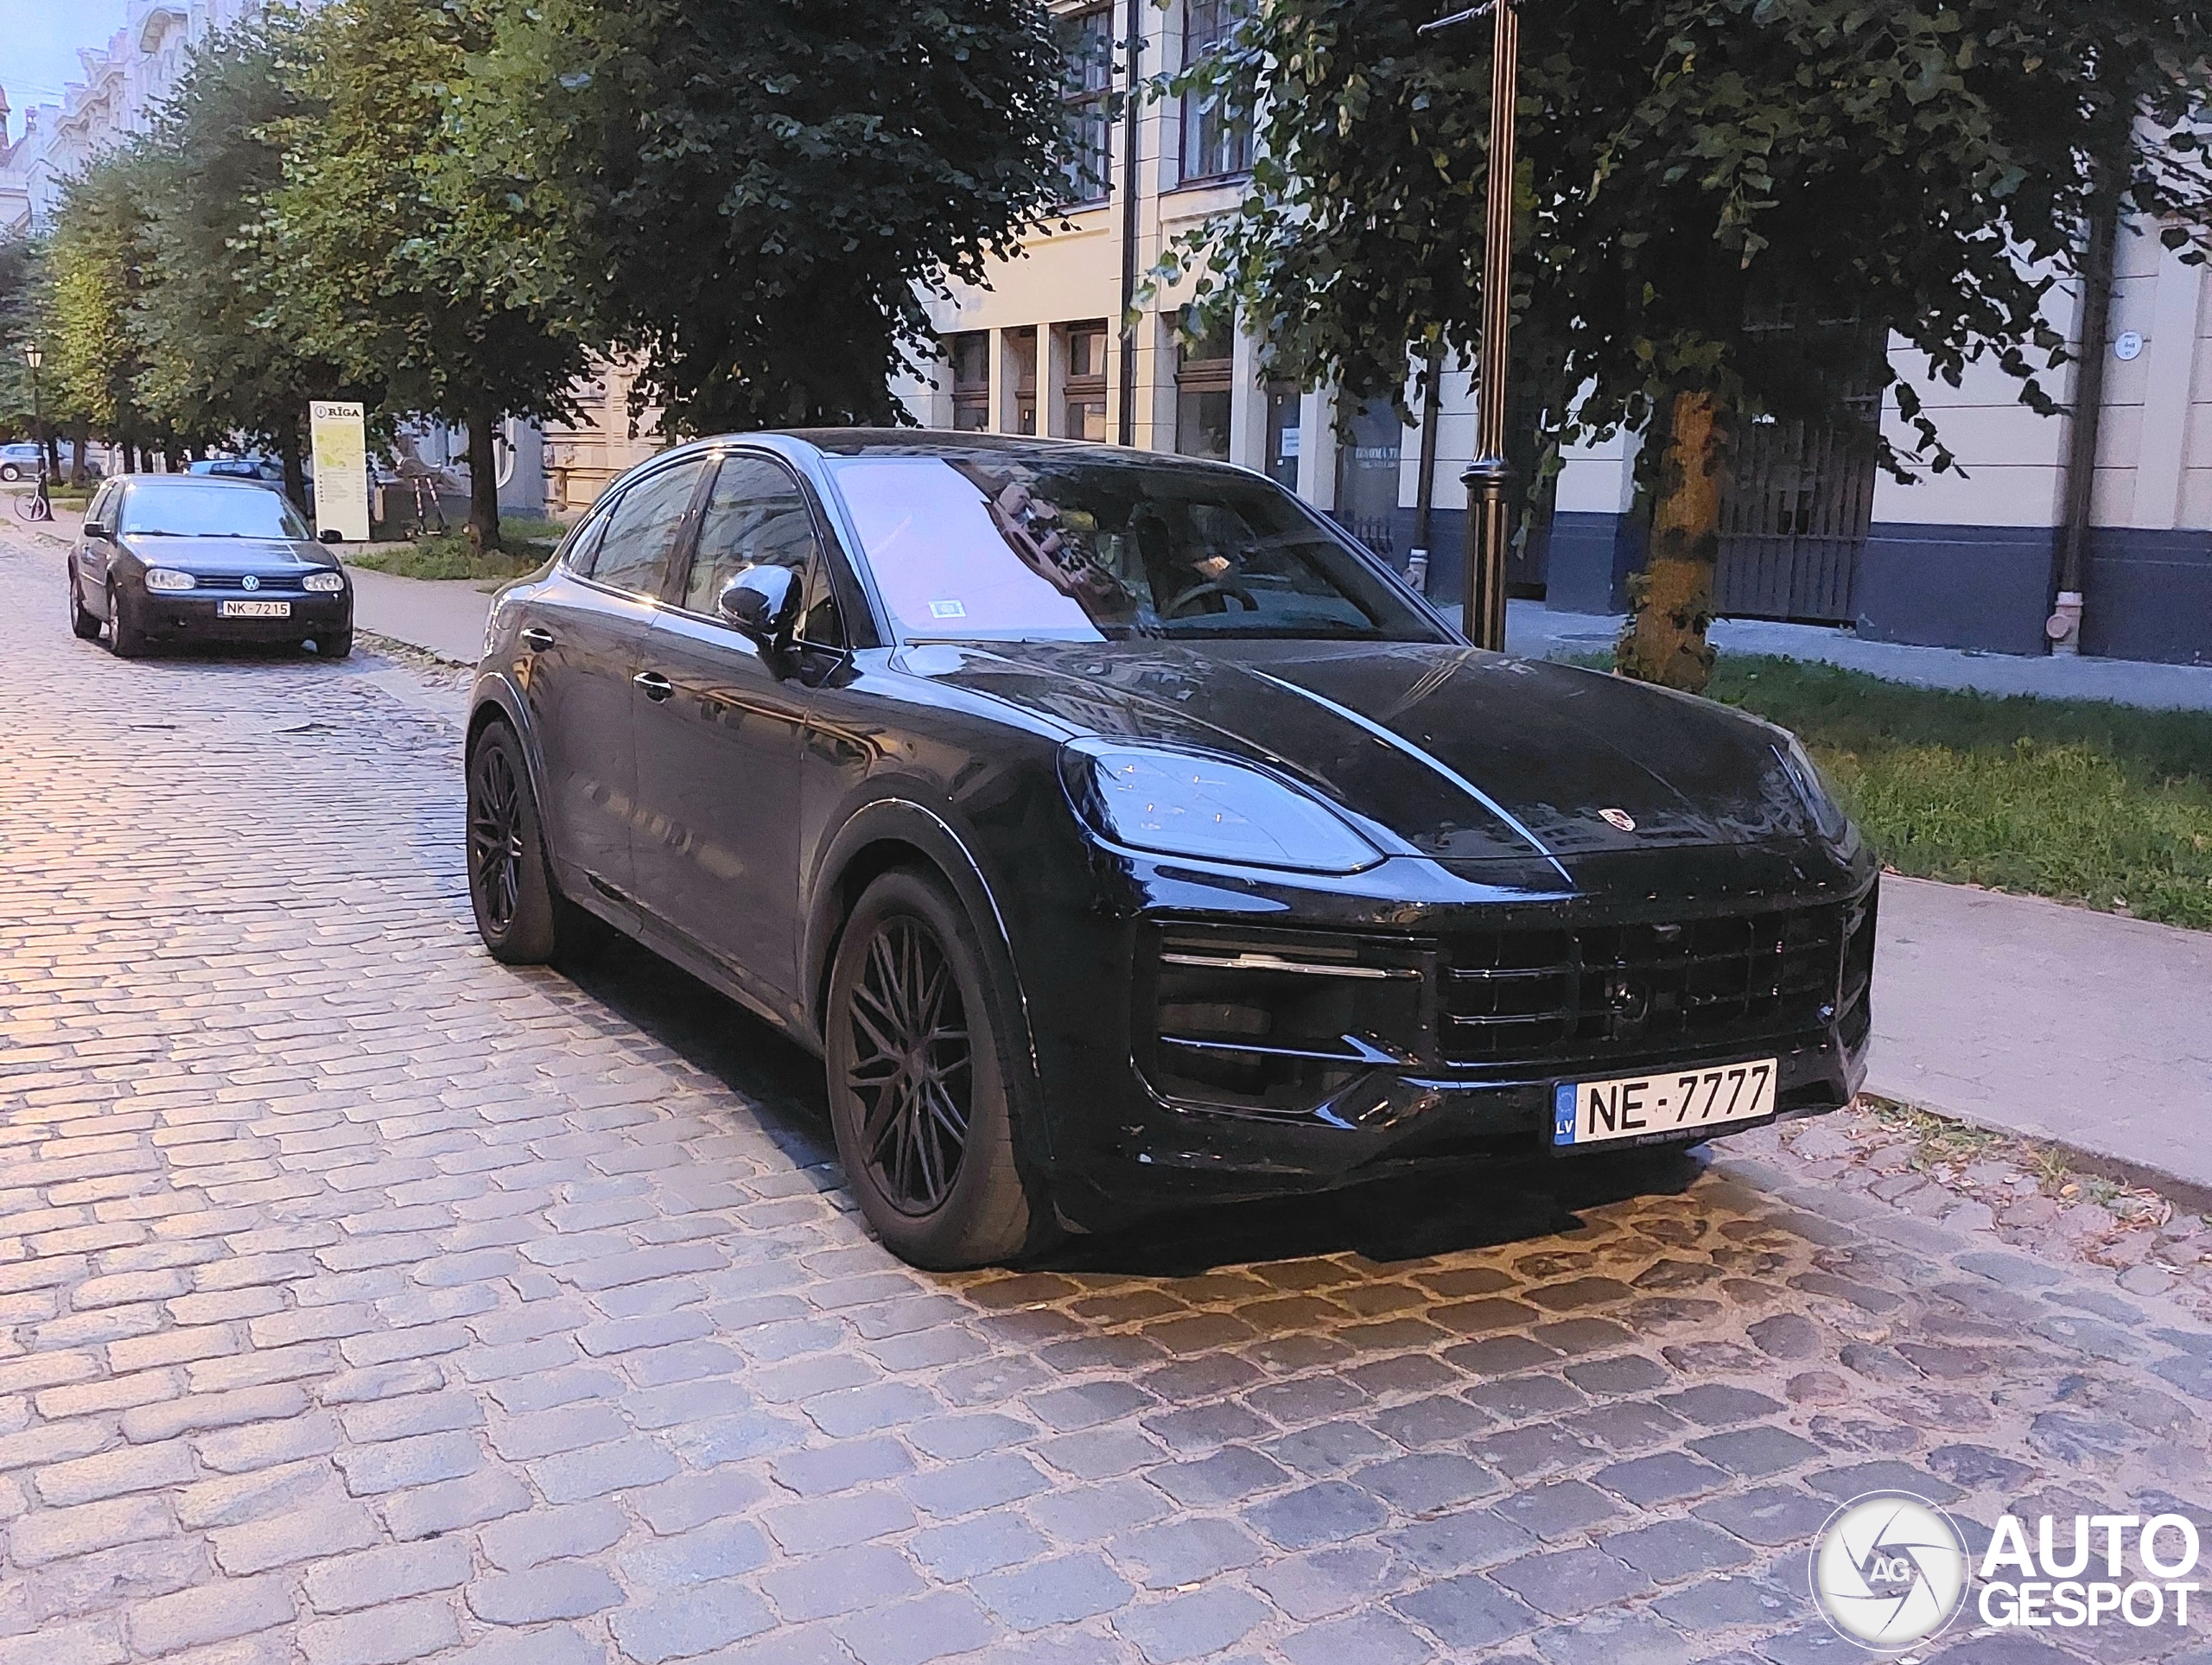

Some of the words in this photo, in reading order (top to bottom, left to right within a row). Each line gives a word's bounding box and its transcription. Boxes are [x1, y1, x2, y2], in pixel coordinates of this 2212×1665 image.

[327, 406, 360, 416] RĪGA
[1555, 1119, 1573, 1134] LV
[1588, 1064, 1770, 1134] NE-7777
